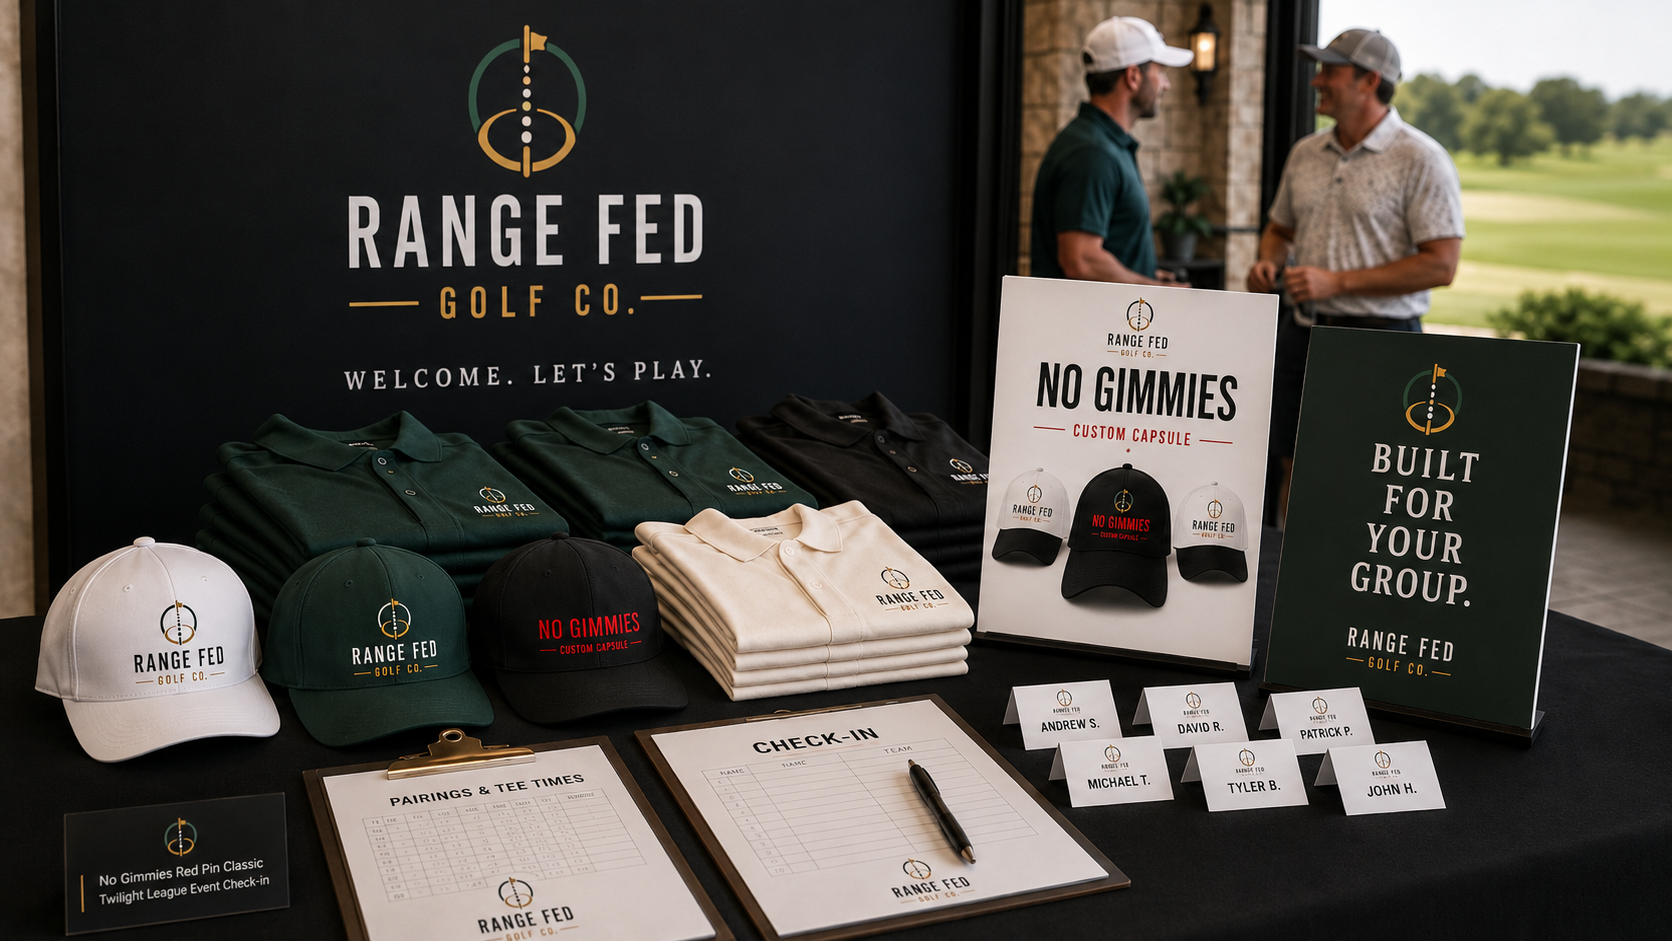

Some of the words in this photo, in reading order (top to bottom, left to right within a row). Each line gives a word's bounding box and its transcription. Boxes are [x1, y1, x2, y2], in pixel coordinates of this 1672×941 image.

[348, 194, 564, 268] RANGE
[599, 194, 704, 265] FED
[439, 285, 544, 319] GOLF
[575, 283, 635, 316] CO.
[1107, 333, 1144, 348] RANGE
[1148, 335, 1168, 349] FED
[344, 365, 513, 390] WELCOME.
[634, 359, 711, 380] PLAY.
[1036, 361, 1082, 409] NO
[1094, 366, 1238, 422] GIMMIES
[1073, 424, 1126, 441] CUSTOM
[1132, 428, 1191, 446] CAPSULE
[1371, 442, 1479, 483] BUILT
[1383, 484, 1454, 522] FOR
[1092, 514, 1106, 528] NO
[1108, 515, 1150, 532] GIMMIES
[1366, 522, 1463, 564] YOUR
[876, 591, 919, 605] RANGE
[919, 589, 945, 600] FED
[1350, 561, 1471, 607] GROUP.
[538, 619, 563, 640] NO
[570, 612, 640, 639] GIMMIES
[352, 644, 405, 665] RANGE
[412, 639, 437, 659] FED
[560, 643, 593, 655] CUSTOM
[596, 640, 628, 652] CAPSULE
[1347, 627, 1409, 655] RANGE
[1418, 637, 1454, 662] FED
[133, 650, 190, 673] RANGE
[198, 645, 224, 666] FED
[374, 665, 401, 677] GOLF
[407, 663, 422, 674] CO.
[1368, 656, 1400, 672] GOLF
[1408, 662, 1428, 677] CO.
[158, 672, 185, 686] GOLF
[192, 671, 208, 682] CO.
[1041, 718, 1086, 732] ANDREW
[1089, 718, 1100, 728] S.
[1177, 722, 1210, 734] DAVID
[1212, 721, 1224, 731] R.
[1300, 727, 1342, 739] PATRICK
[1343, 726, 1353, 736] P.
[752, 727, 880, 754] CHECK-IN
[389, 788, 473, 806] PAIRINGS
[479, 786, 490, 795] &
[494, 781, 528, 794] TEE
[531, 773, 585, 789] TIMES
[1087, 776, 1139, 790] MICHAEL
[1139, 774, 1151, 786] T.
[1227, 781, 1266, 794] TYLER
[1268, 779, 1281, 791] B.
[1367, 783, 1401, 797] JOHN
[1403, 782, 1417, 794] H.
[99, 875, 117, 886] No
[120, 868, 173, 884] Gimmies
[176, 865, 199, 877] Red
[202, 862, 220, 874] Pin
[223, 858, 264, 872] Classic
[99, 889, 144, 905] Twilight
[147, 884, 188, 900] League
[190, 882, 220, 894] Event
[222, 875, 270, 890] Check-in
[891, 881, 941, 898] RANGE
[941, 876, 971, 890] FED
[477, 911, 537, 934] RANGE
[541, 906, 574, 924] FED
